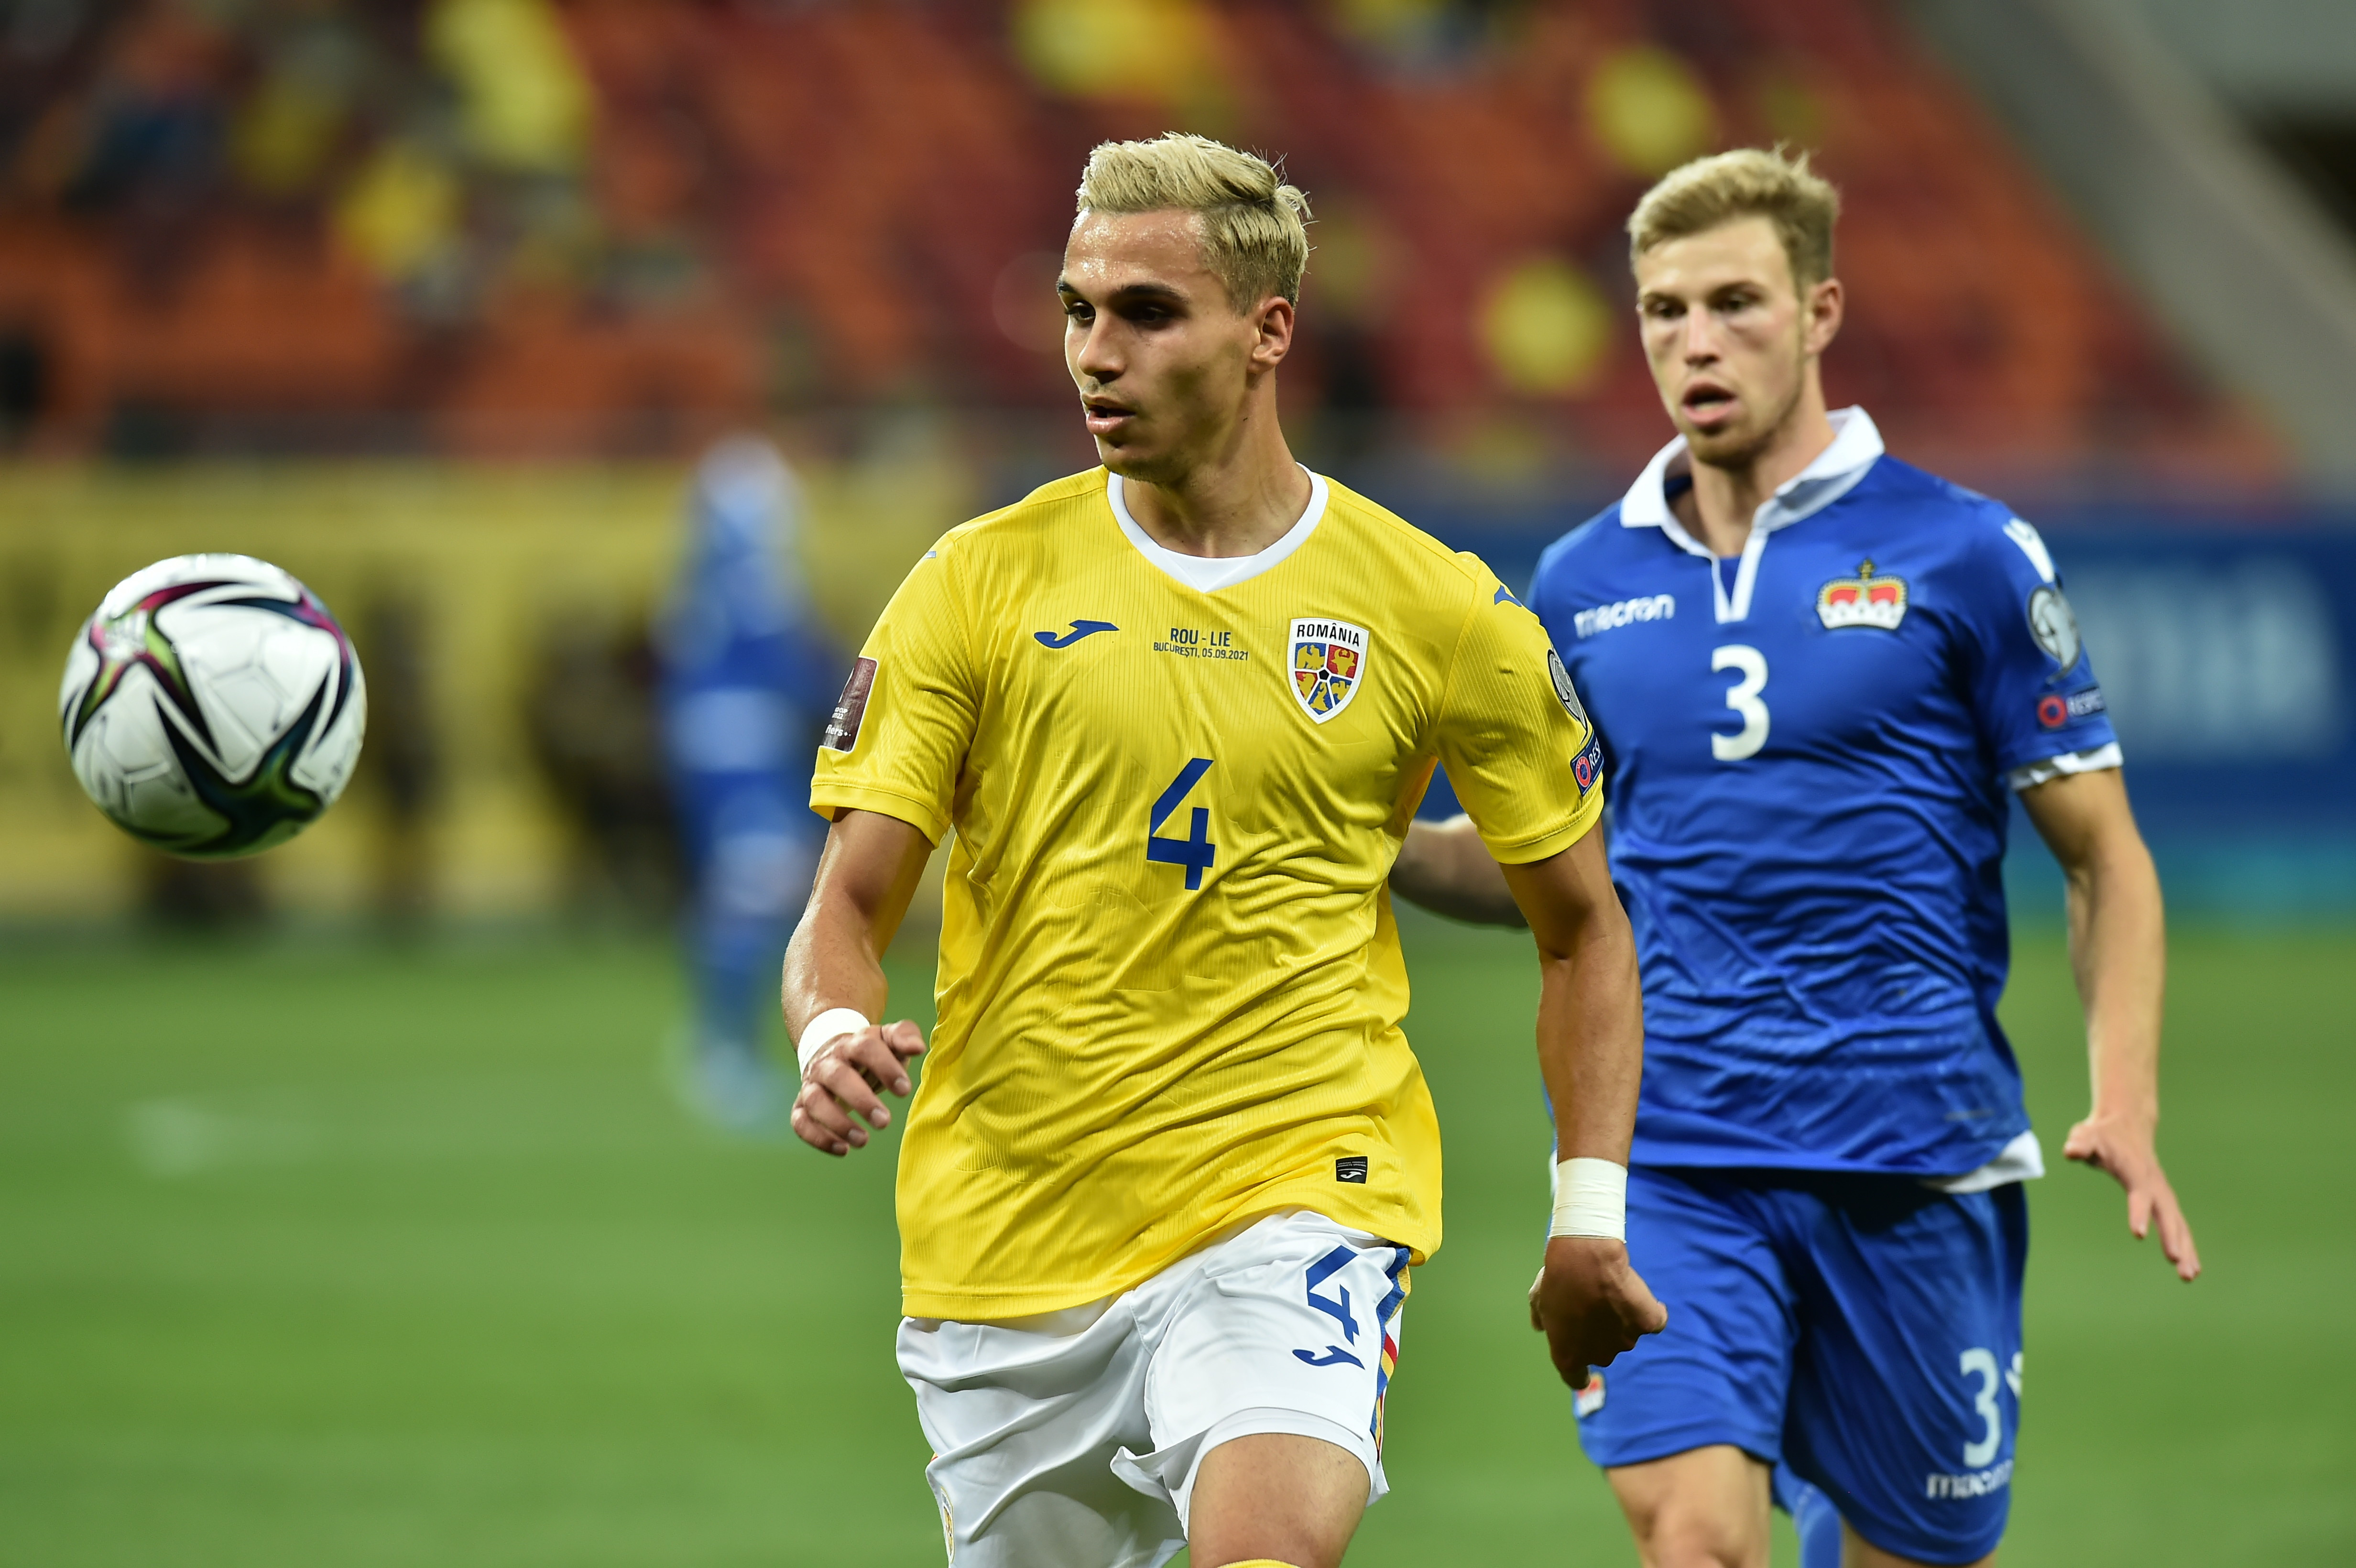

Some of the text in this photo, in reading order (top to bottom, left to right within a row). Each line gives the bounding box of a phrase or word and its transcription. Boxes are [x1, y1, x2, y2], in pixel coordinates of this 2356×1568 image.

[1170, 628, 1199, 644] ROU
[1210, 631, 1232, 647] LIE
[1297, 622, 1360, 647] ROMÂNIA
[1574, 594, 1675, 639] macron
[1201, 647, 1249, 661] 05.09.2021
[1711, 643, 1770, 762] 3
[1146, 757, 1215, 891] 4
[1306, 1245, 1360, 1347] 4
[1960, 1347, 2002, 1468] 3
